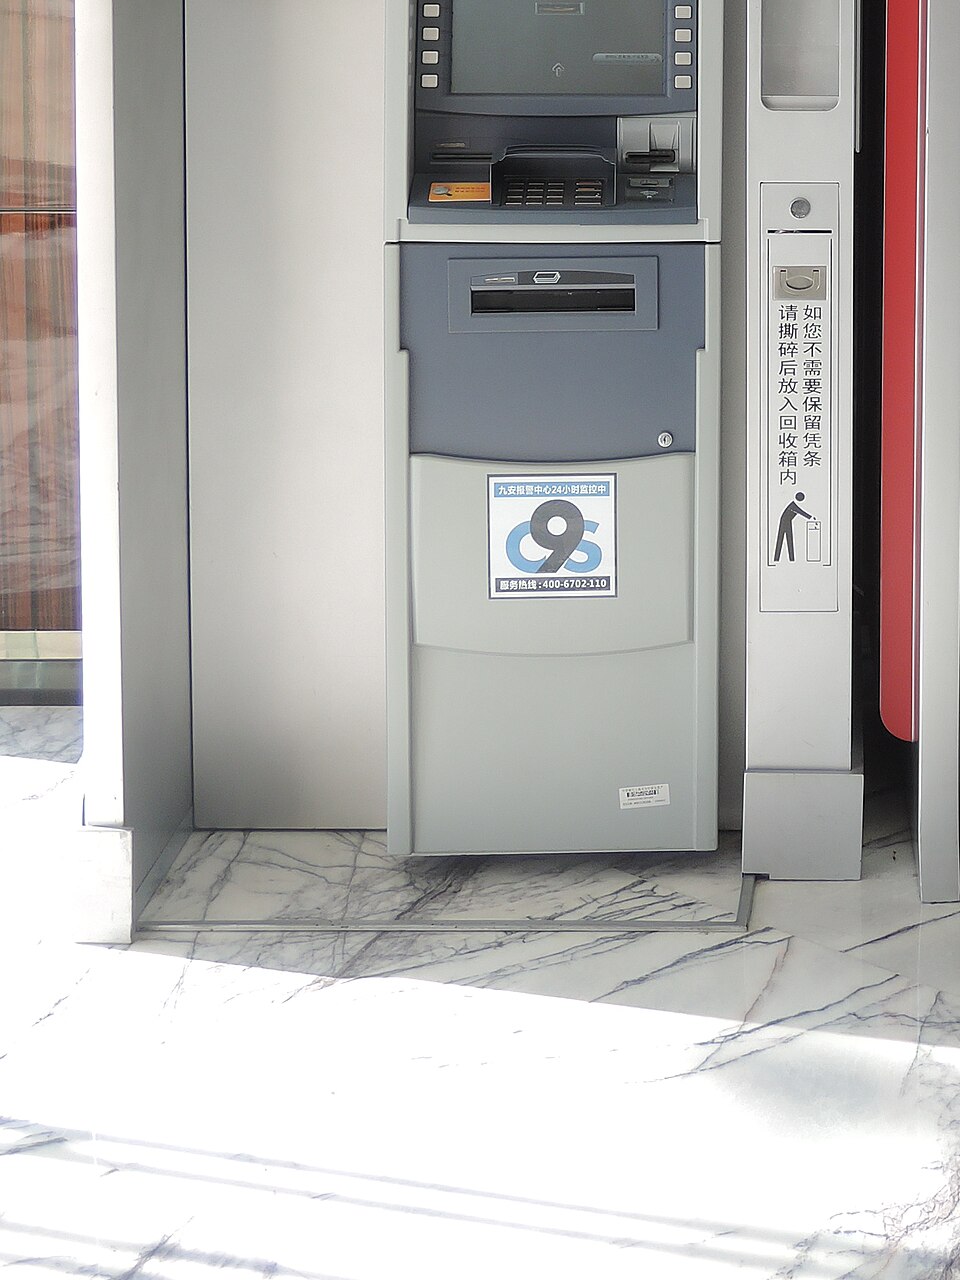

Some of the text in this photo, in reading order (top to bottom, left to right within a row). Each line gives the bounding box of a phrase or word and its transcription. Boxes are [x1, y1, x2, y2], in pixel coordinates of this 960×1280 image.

[778, 304, 798, 485] 请撕碎后放入回收箱内
[802, 304, 822, 467] 如您不需要保留凭条
